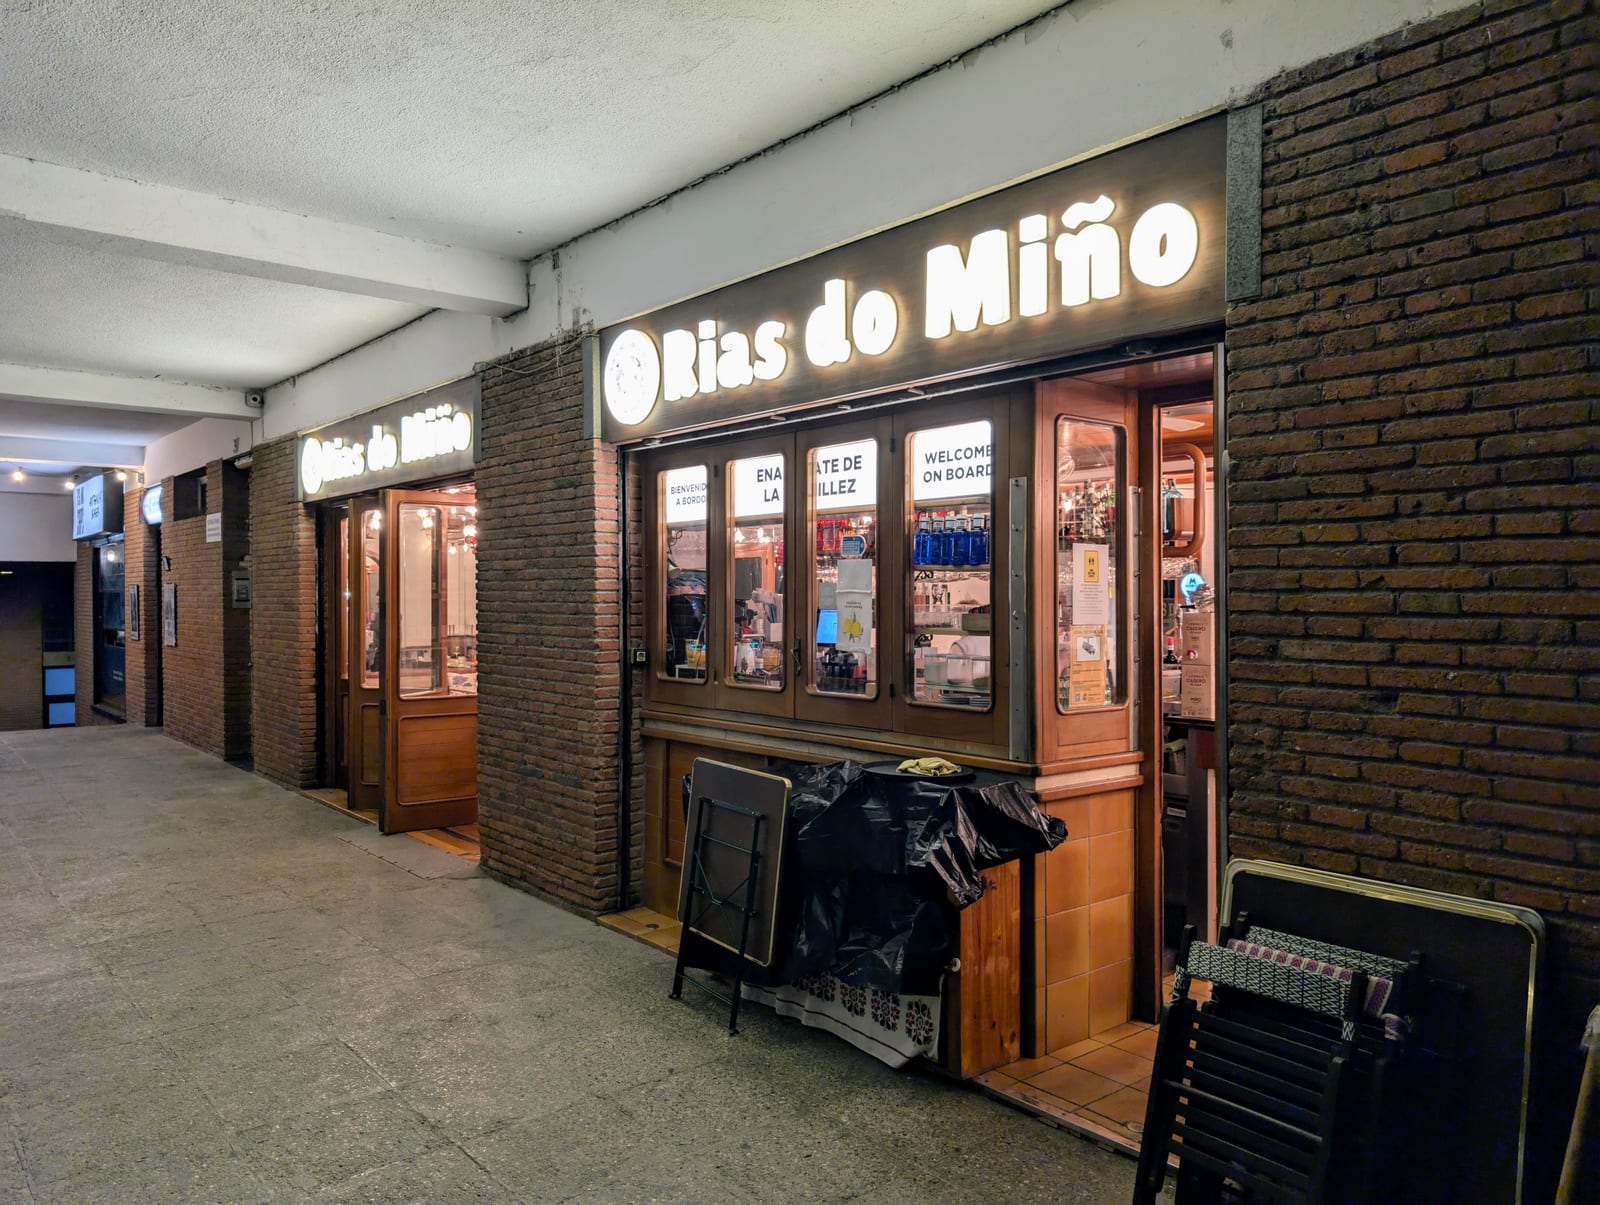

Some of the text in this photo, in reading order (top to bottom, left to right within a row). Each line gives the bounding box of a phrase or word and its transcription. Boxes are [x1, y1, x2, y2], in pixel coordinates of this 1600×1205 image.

[663, 195, 1198, 402] Rias do Miño
[322, 403, 471, 482] Rias do Miño
[843, 455, 862, 472] DE
[925, 444, 992, 465] WELCOME
[923, 463, 992, 483] ON BOARD
[676, 495, 706, 506] A BORDO
[764, 488, 780, 502] LA
